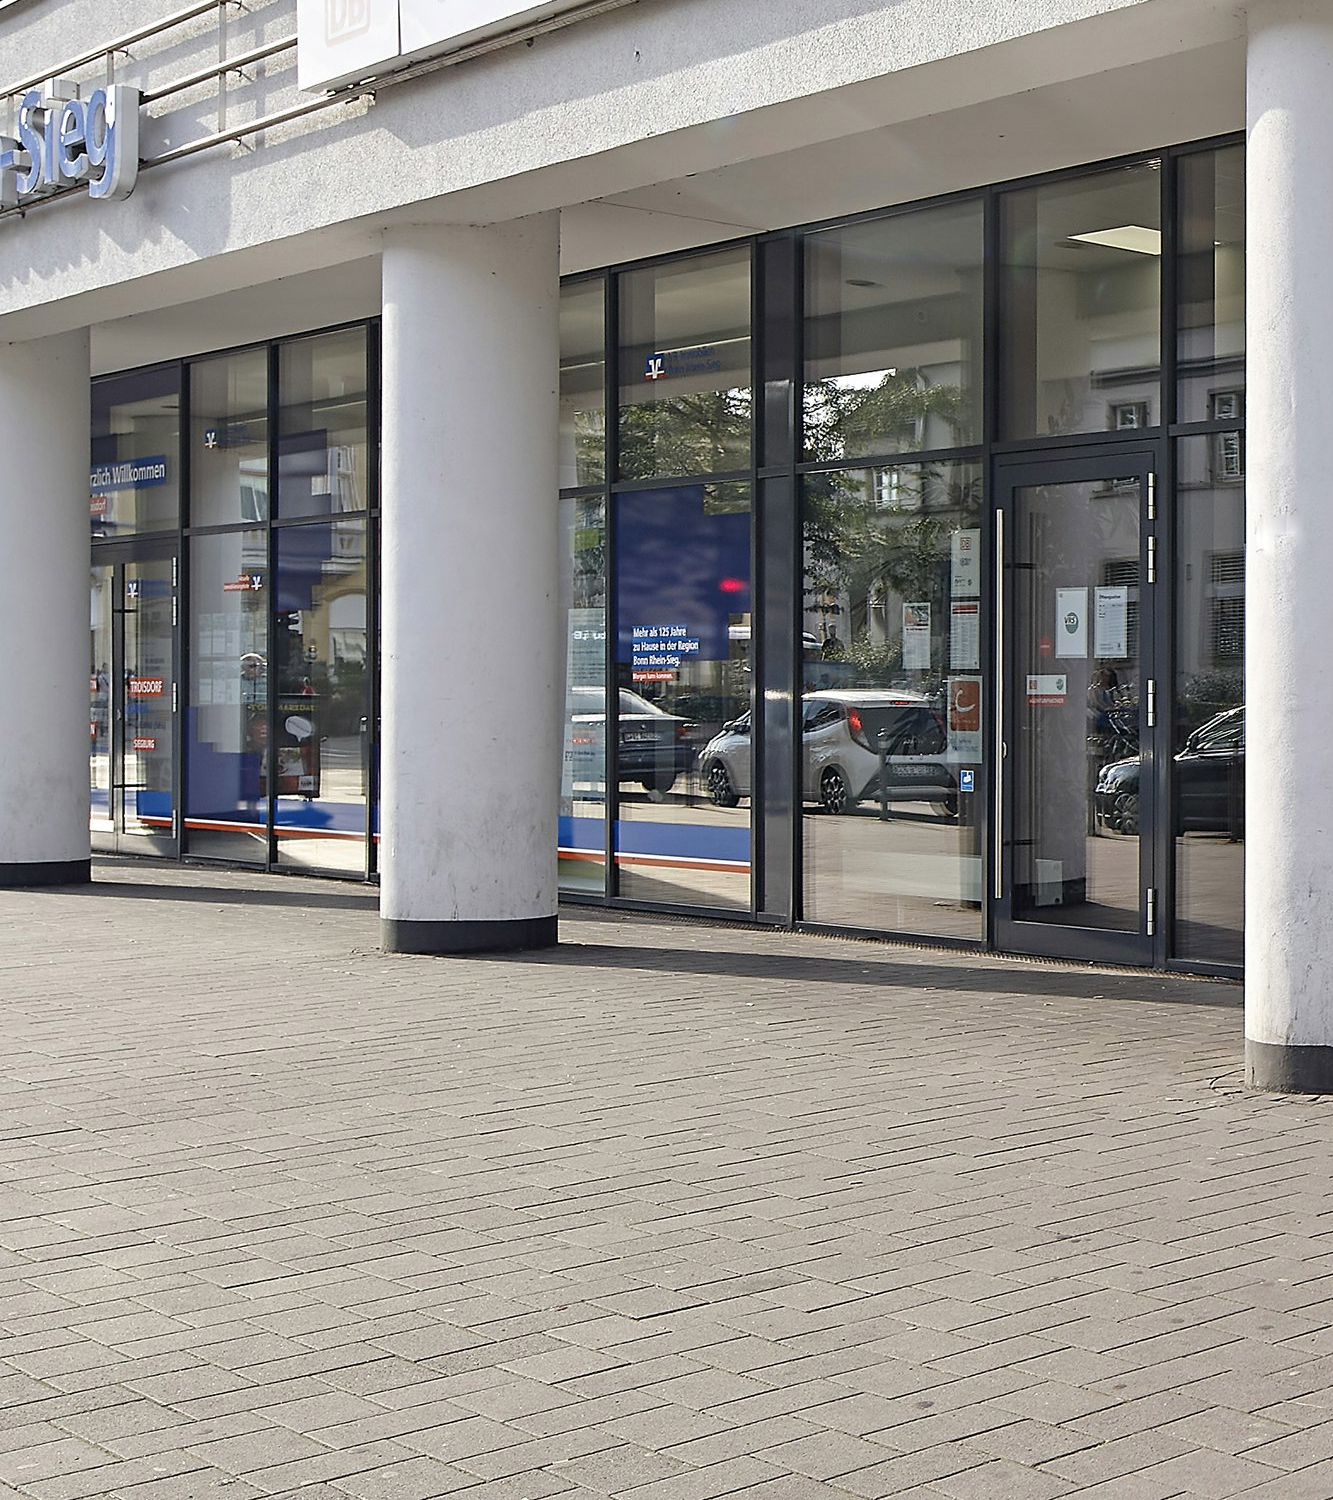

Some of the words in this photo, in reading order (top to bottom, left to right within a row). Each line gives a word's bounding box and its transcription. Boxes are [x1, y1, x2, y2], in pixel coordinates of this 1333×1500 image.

[112, 462, 166, 484] Willkommen
[633, 627, 649, 638] Mehr
[649, 626, 658, 638] als
[659, 626, 670, 637] 125
[670, 626, 687, 637] Jahre
[633, 643, 641, 652] zu
[641, 641, 660, 652] Hause
[660, 640, 666, 651] in
[666, 640, 677, 651] der
[678, 639, 699, 653] Region
[633, 655, 649, 666] Bonn
[649, 654, 681, 667] Rhein-Sieg.
[130, 681, 163, 693] TROISDORF
